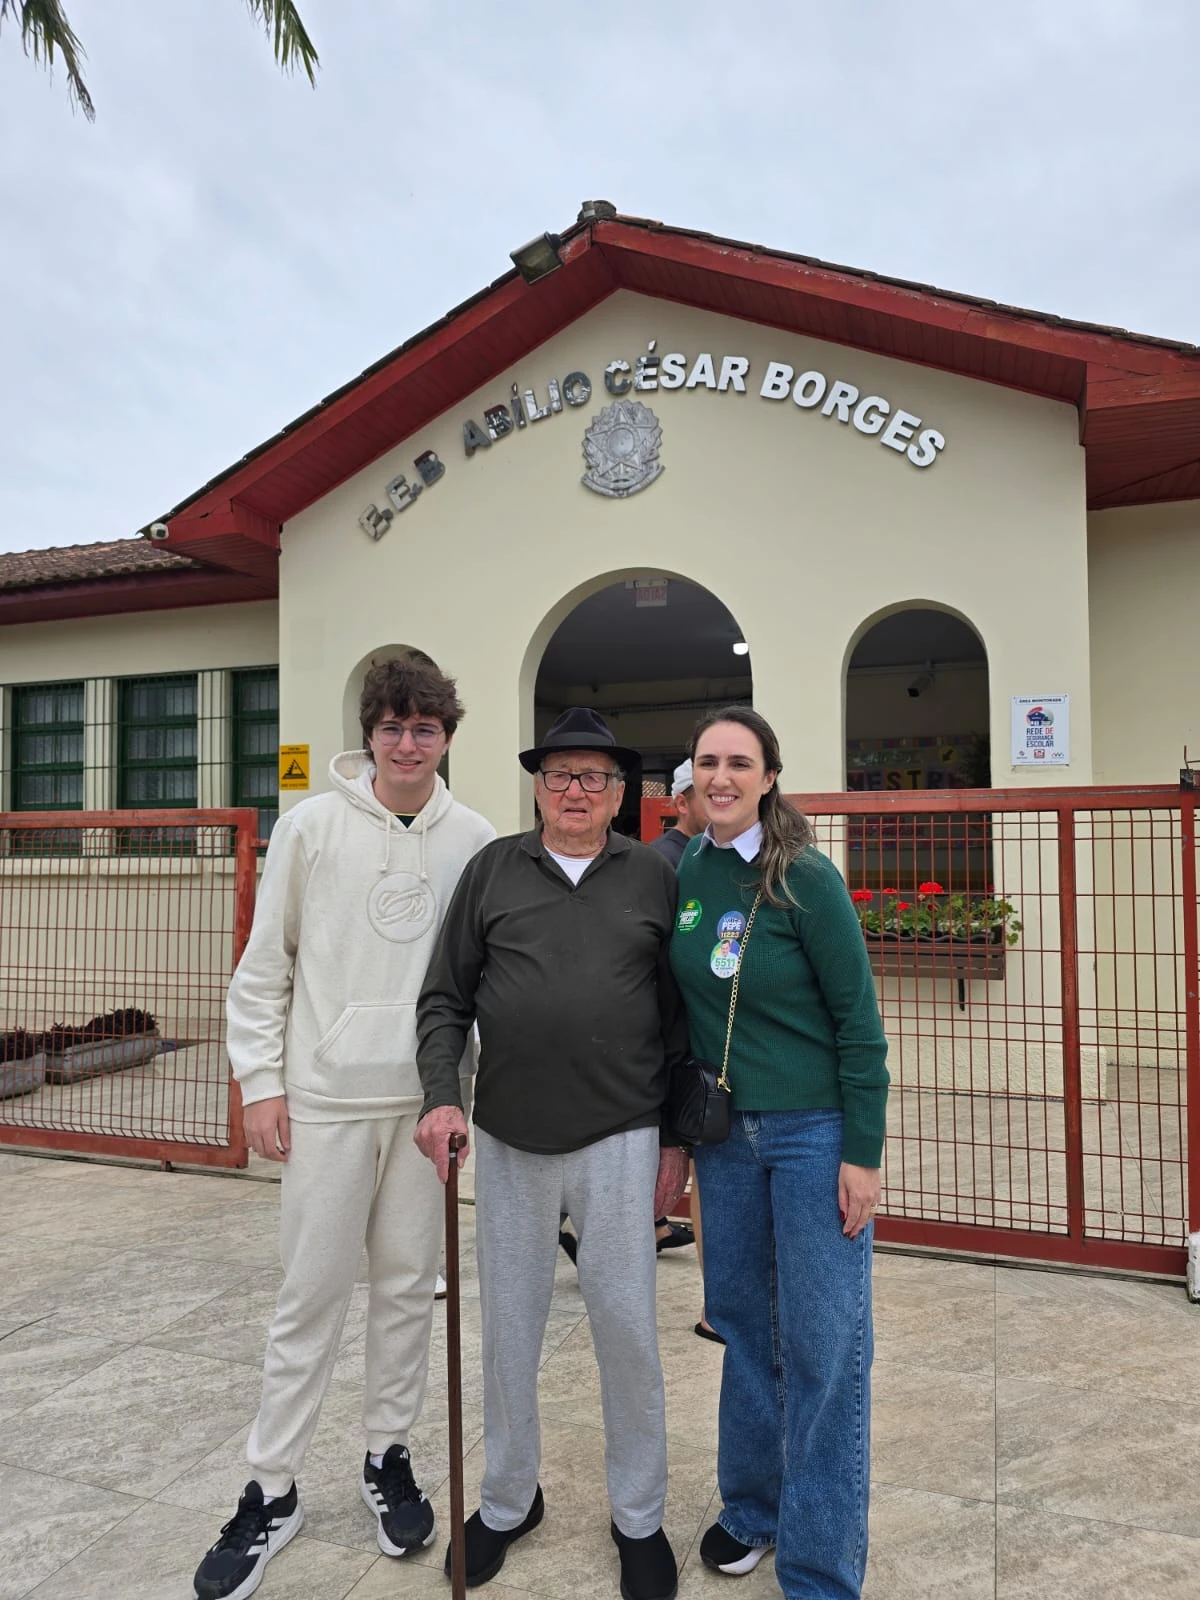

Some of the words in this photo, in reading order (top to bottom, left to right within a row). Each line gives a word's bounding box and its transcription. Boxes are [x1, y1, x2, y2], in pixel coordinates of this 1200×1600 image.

[462, 371, 592, 457] ABÍLIO
[604, 339, 749, 394] CÉSAR
[760, 361, 946, 468] BORGES
[1026, 727, 1043, 735] REDE
[722, 920, 741, 931] PEPE
[715, 957, 736, 967] 5511
